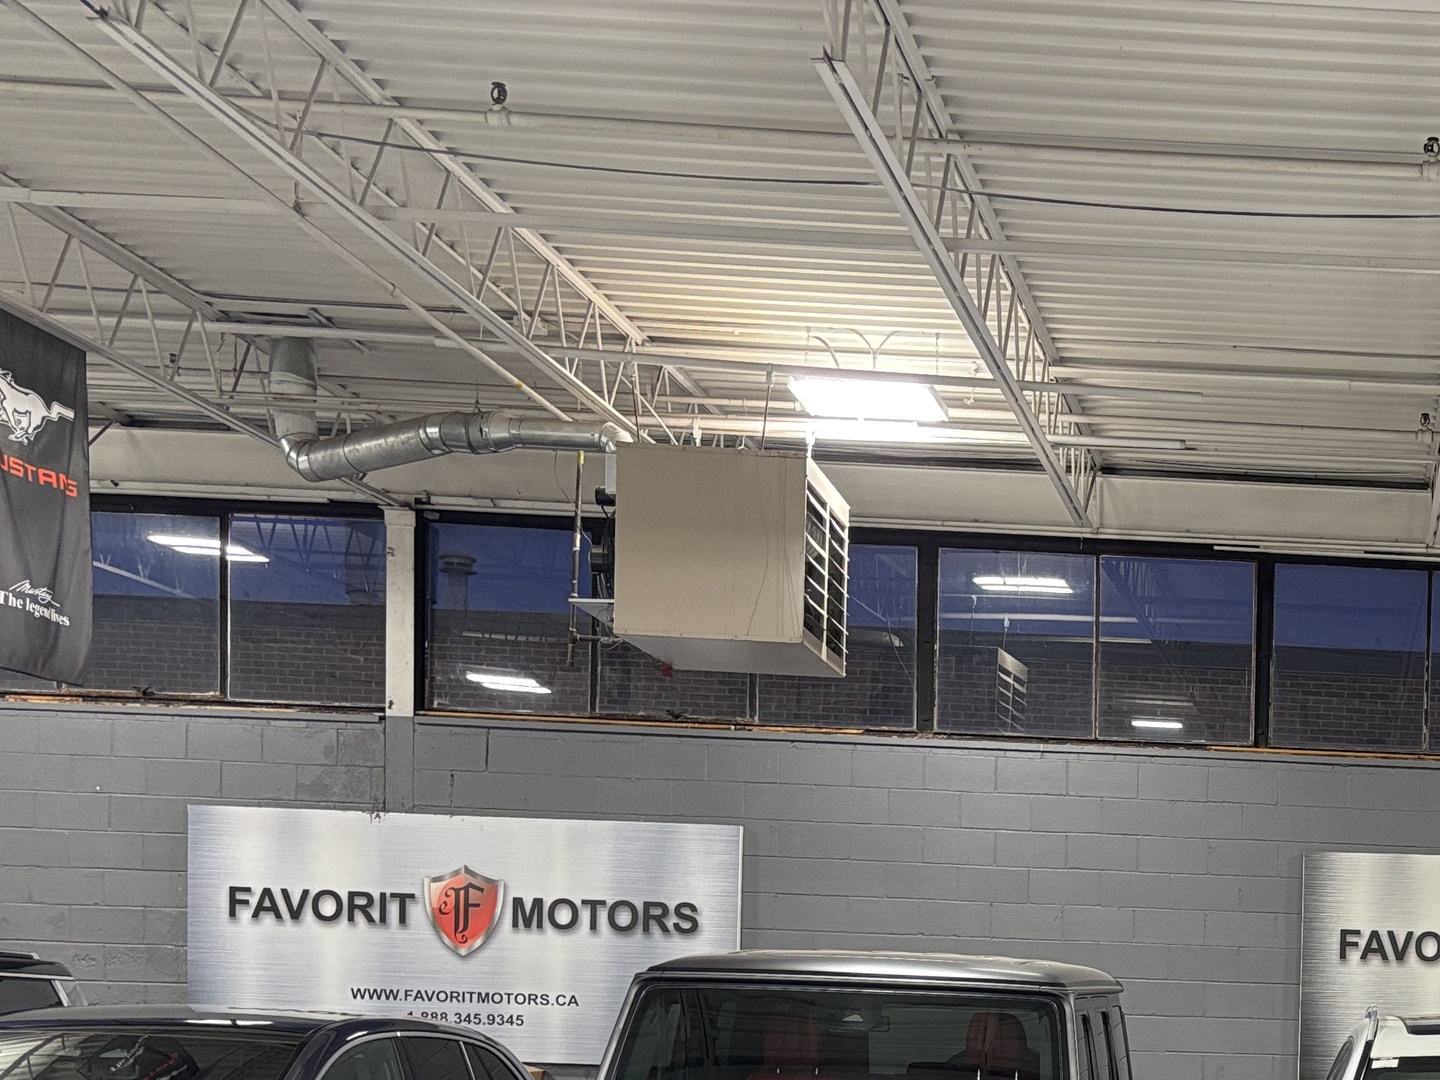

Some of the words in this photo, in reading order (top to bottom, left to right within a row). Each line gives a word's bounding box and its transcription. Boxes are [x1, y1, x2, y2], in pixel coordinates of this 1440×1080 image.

[0, 454, 78, 498] USTANG
[0, 590, 23, 609] The
[227, 885, 415, 925] FAVORIT
[511, 896, 700, 935] MOTORS
[351, 988, 580, 1007] WWW.FAVORITMOTORS.CA
[407, 1010, 525, 1027] 888.345.9345
